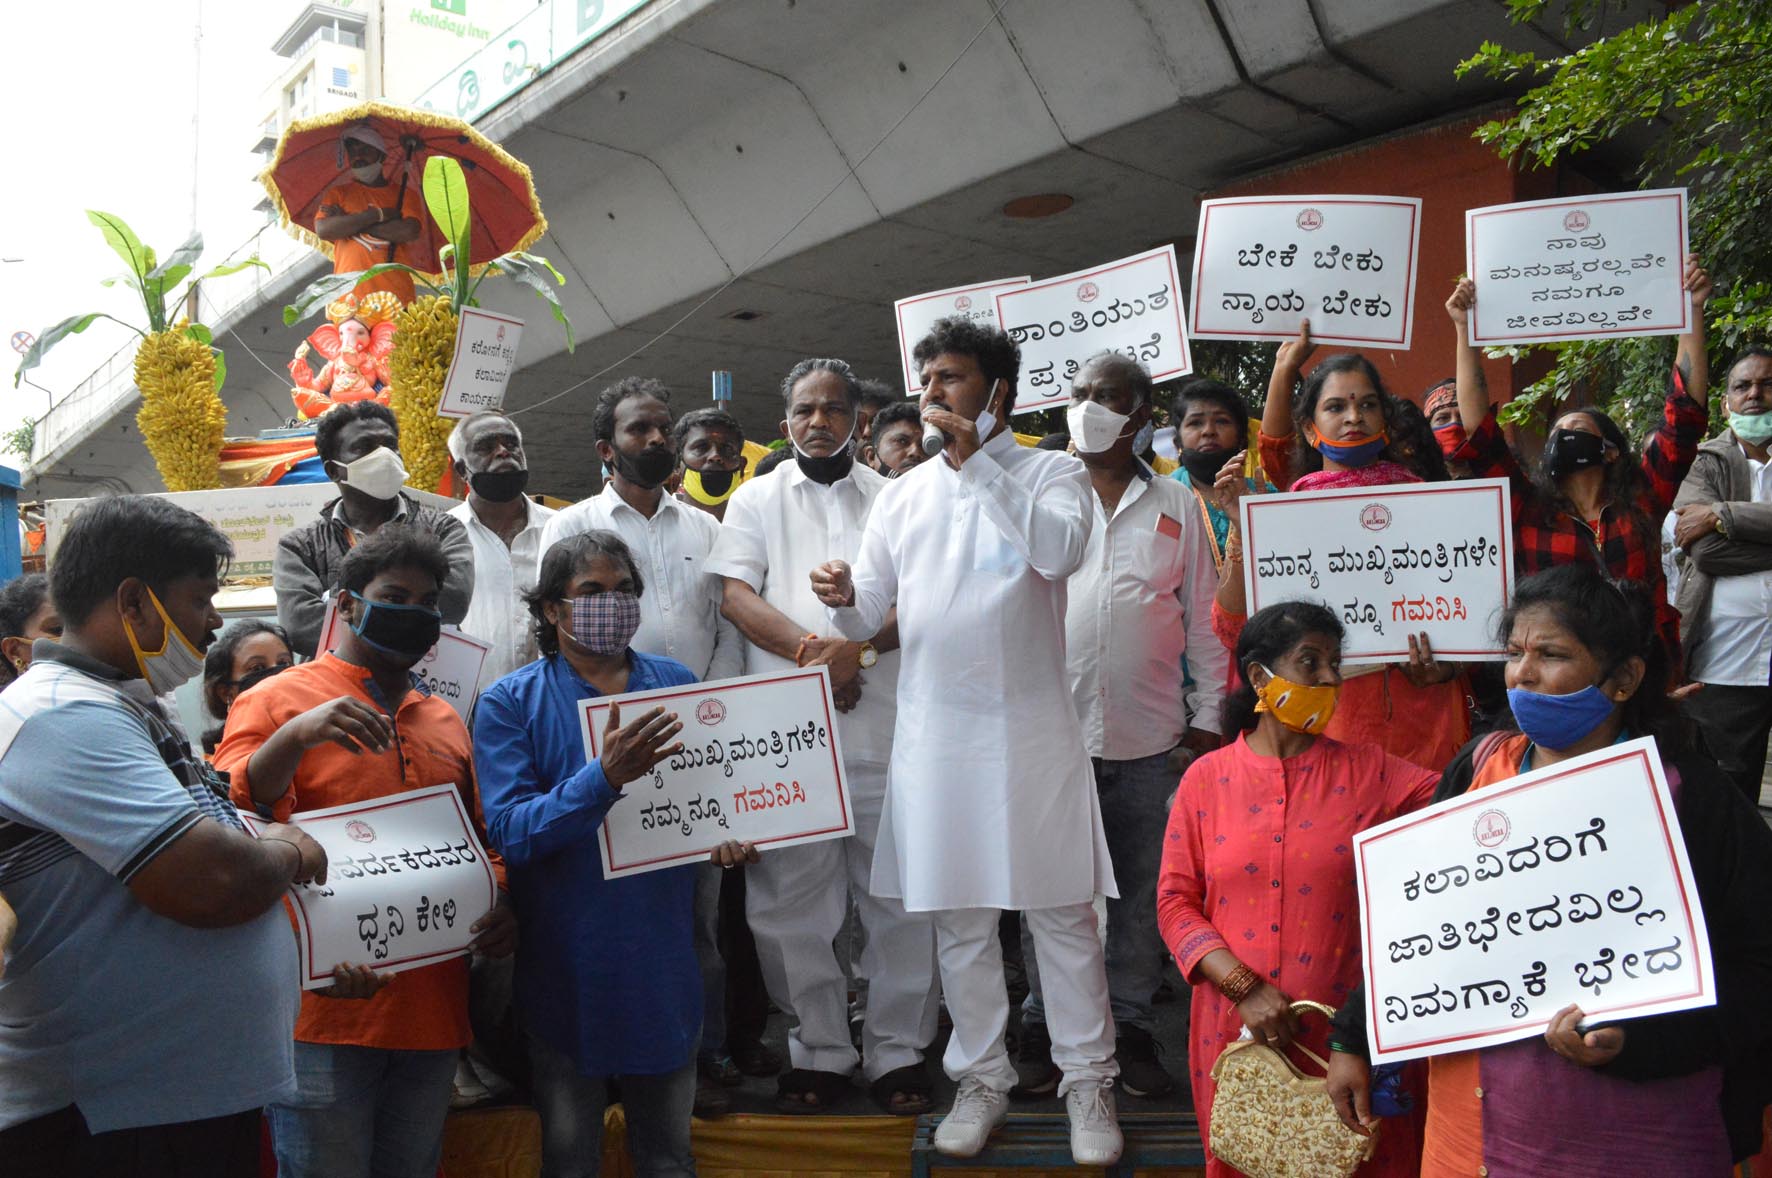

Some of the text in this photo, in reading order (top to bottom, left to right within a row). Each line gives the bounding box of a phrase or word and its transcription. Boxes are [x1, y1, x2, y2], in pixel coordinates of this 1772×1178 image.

[409, 8, 465, 38] Holiday
[327, 87, 358, 99] BRIGADE
[1238, 243, 1383, 272] ಬೇಕೆ ಬೇಕು
[1546, 232, 1607, 250] ನಾವು
[1490, 253, 1666, 280] ಮನುಷ್ಯರಲ್ಲವೇ
[1222, 288, 1392, 324] ನ್ಯಾಯ ಬೇಕು
[1532, 284, 1625, 302] ನಮಗೂ
[1008, 284, 1169, 344] ಶಾಂತಿಯುತ
[1506, 305, 1653, 329] ಜೀವವಿಲ್ಲವೇ
[1258, 536, 1498, 589] ಮಾನ್ಯ ಮುಖ್ಯಮಂತ್ರಿಗಳೇ
[1392, 593, 1468, 621] ಗಮನಿಸಿ
[671, 720, 828, 777] ಮುಖ್ಯಮಂತ್ರಿಗಳೇ
[641, 780, 806, 836] ನಮ್ಮನ್ನೂ ಗಮನಿಸಿ
[1403, 817, 1608, 901] ಕಲಾವಿದರಿಗೆ
[357, 895, 457, 960] ಧ್ವನಿ ಕೇಳಿ
[1388, 885, 1666, 963] ಜಾತಿಭೇದವಿಲ್ಲ
[1385, 935, 1683, 1024] ನಿಮಗ್ಯಾಕೆ ಭೇದ
